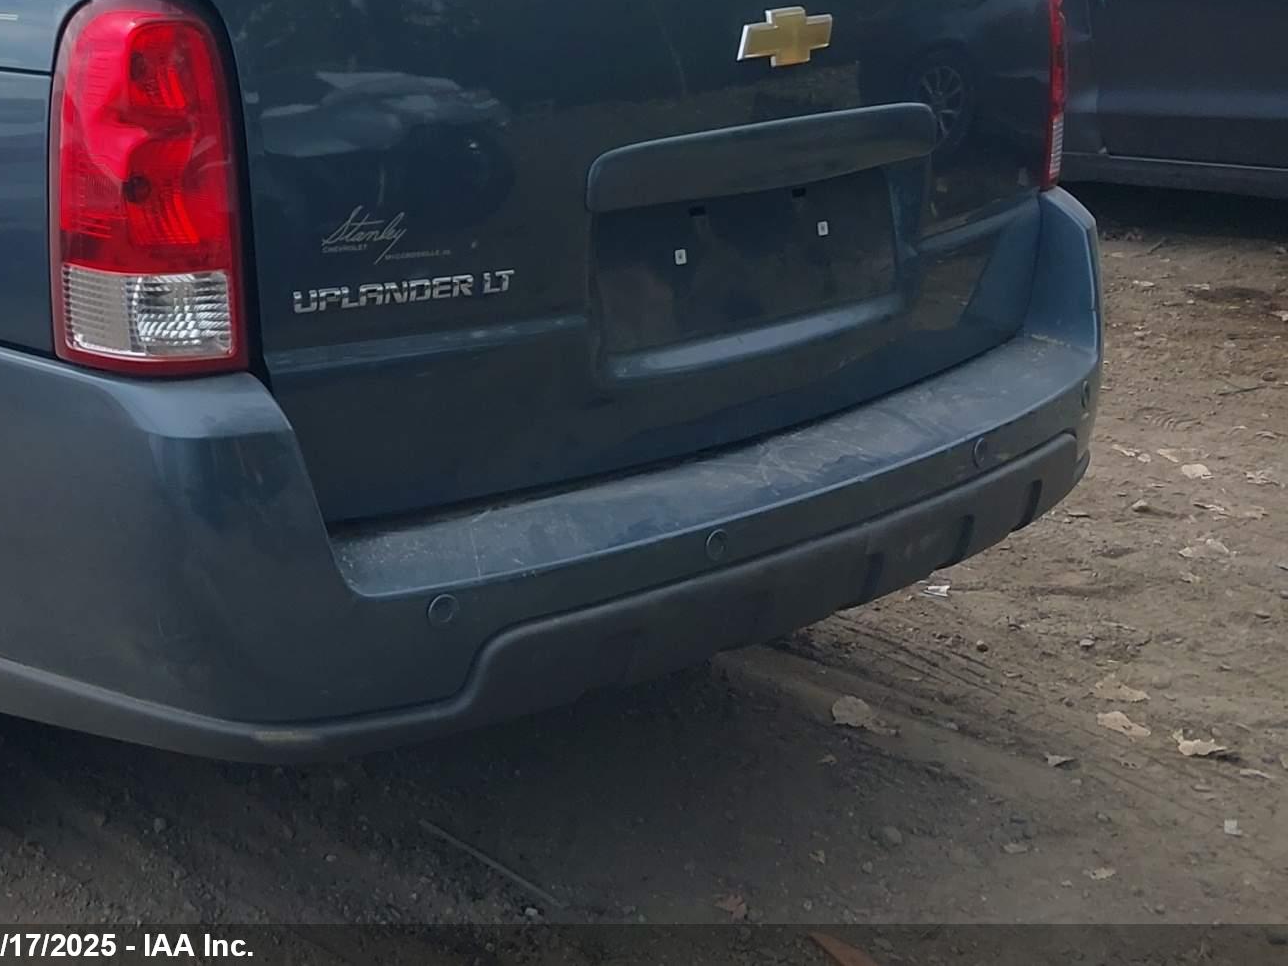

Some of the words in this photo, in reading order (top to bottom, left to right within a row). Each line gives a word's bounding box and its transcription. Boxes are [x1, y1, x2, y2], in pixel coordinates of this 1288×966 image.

[320, 205, 408, 266] Stanley
[292, 273, 475, 314] UPLANDER
[482, 269, 515, 295] LT
